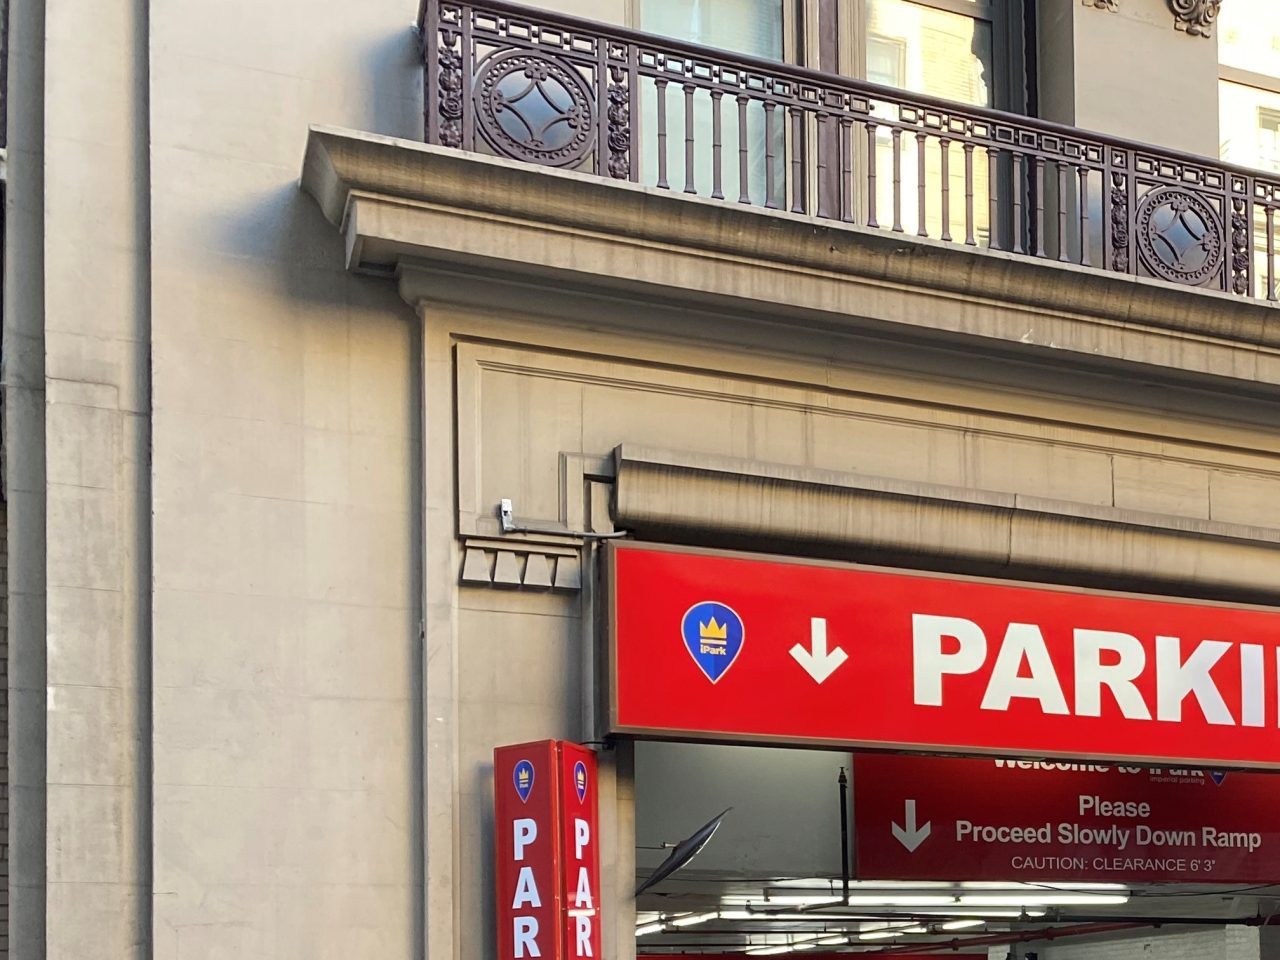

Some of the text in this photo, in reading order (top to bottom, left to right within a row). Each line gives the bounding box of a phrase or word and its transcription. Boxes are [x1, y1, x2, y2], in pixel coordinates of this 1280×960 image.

[700, 644, 727, 656] iPark
[1079, 794, 1150, 817] Please
[956, 820, 1261, 852] Proceed Slowly Down Ramp
[1011, 856, 1216, 872] CAUTION: CLEARANCE 6' 3"
